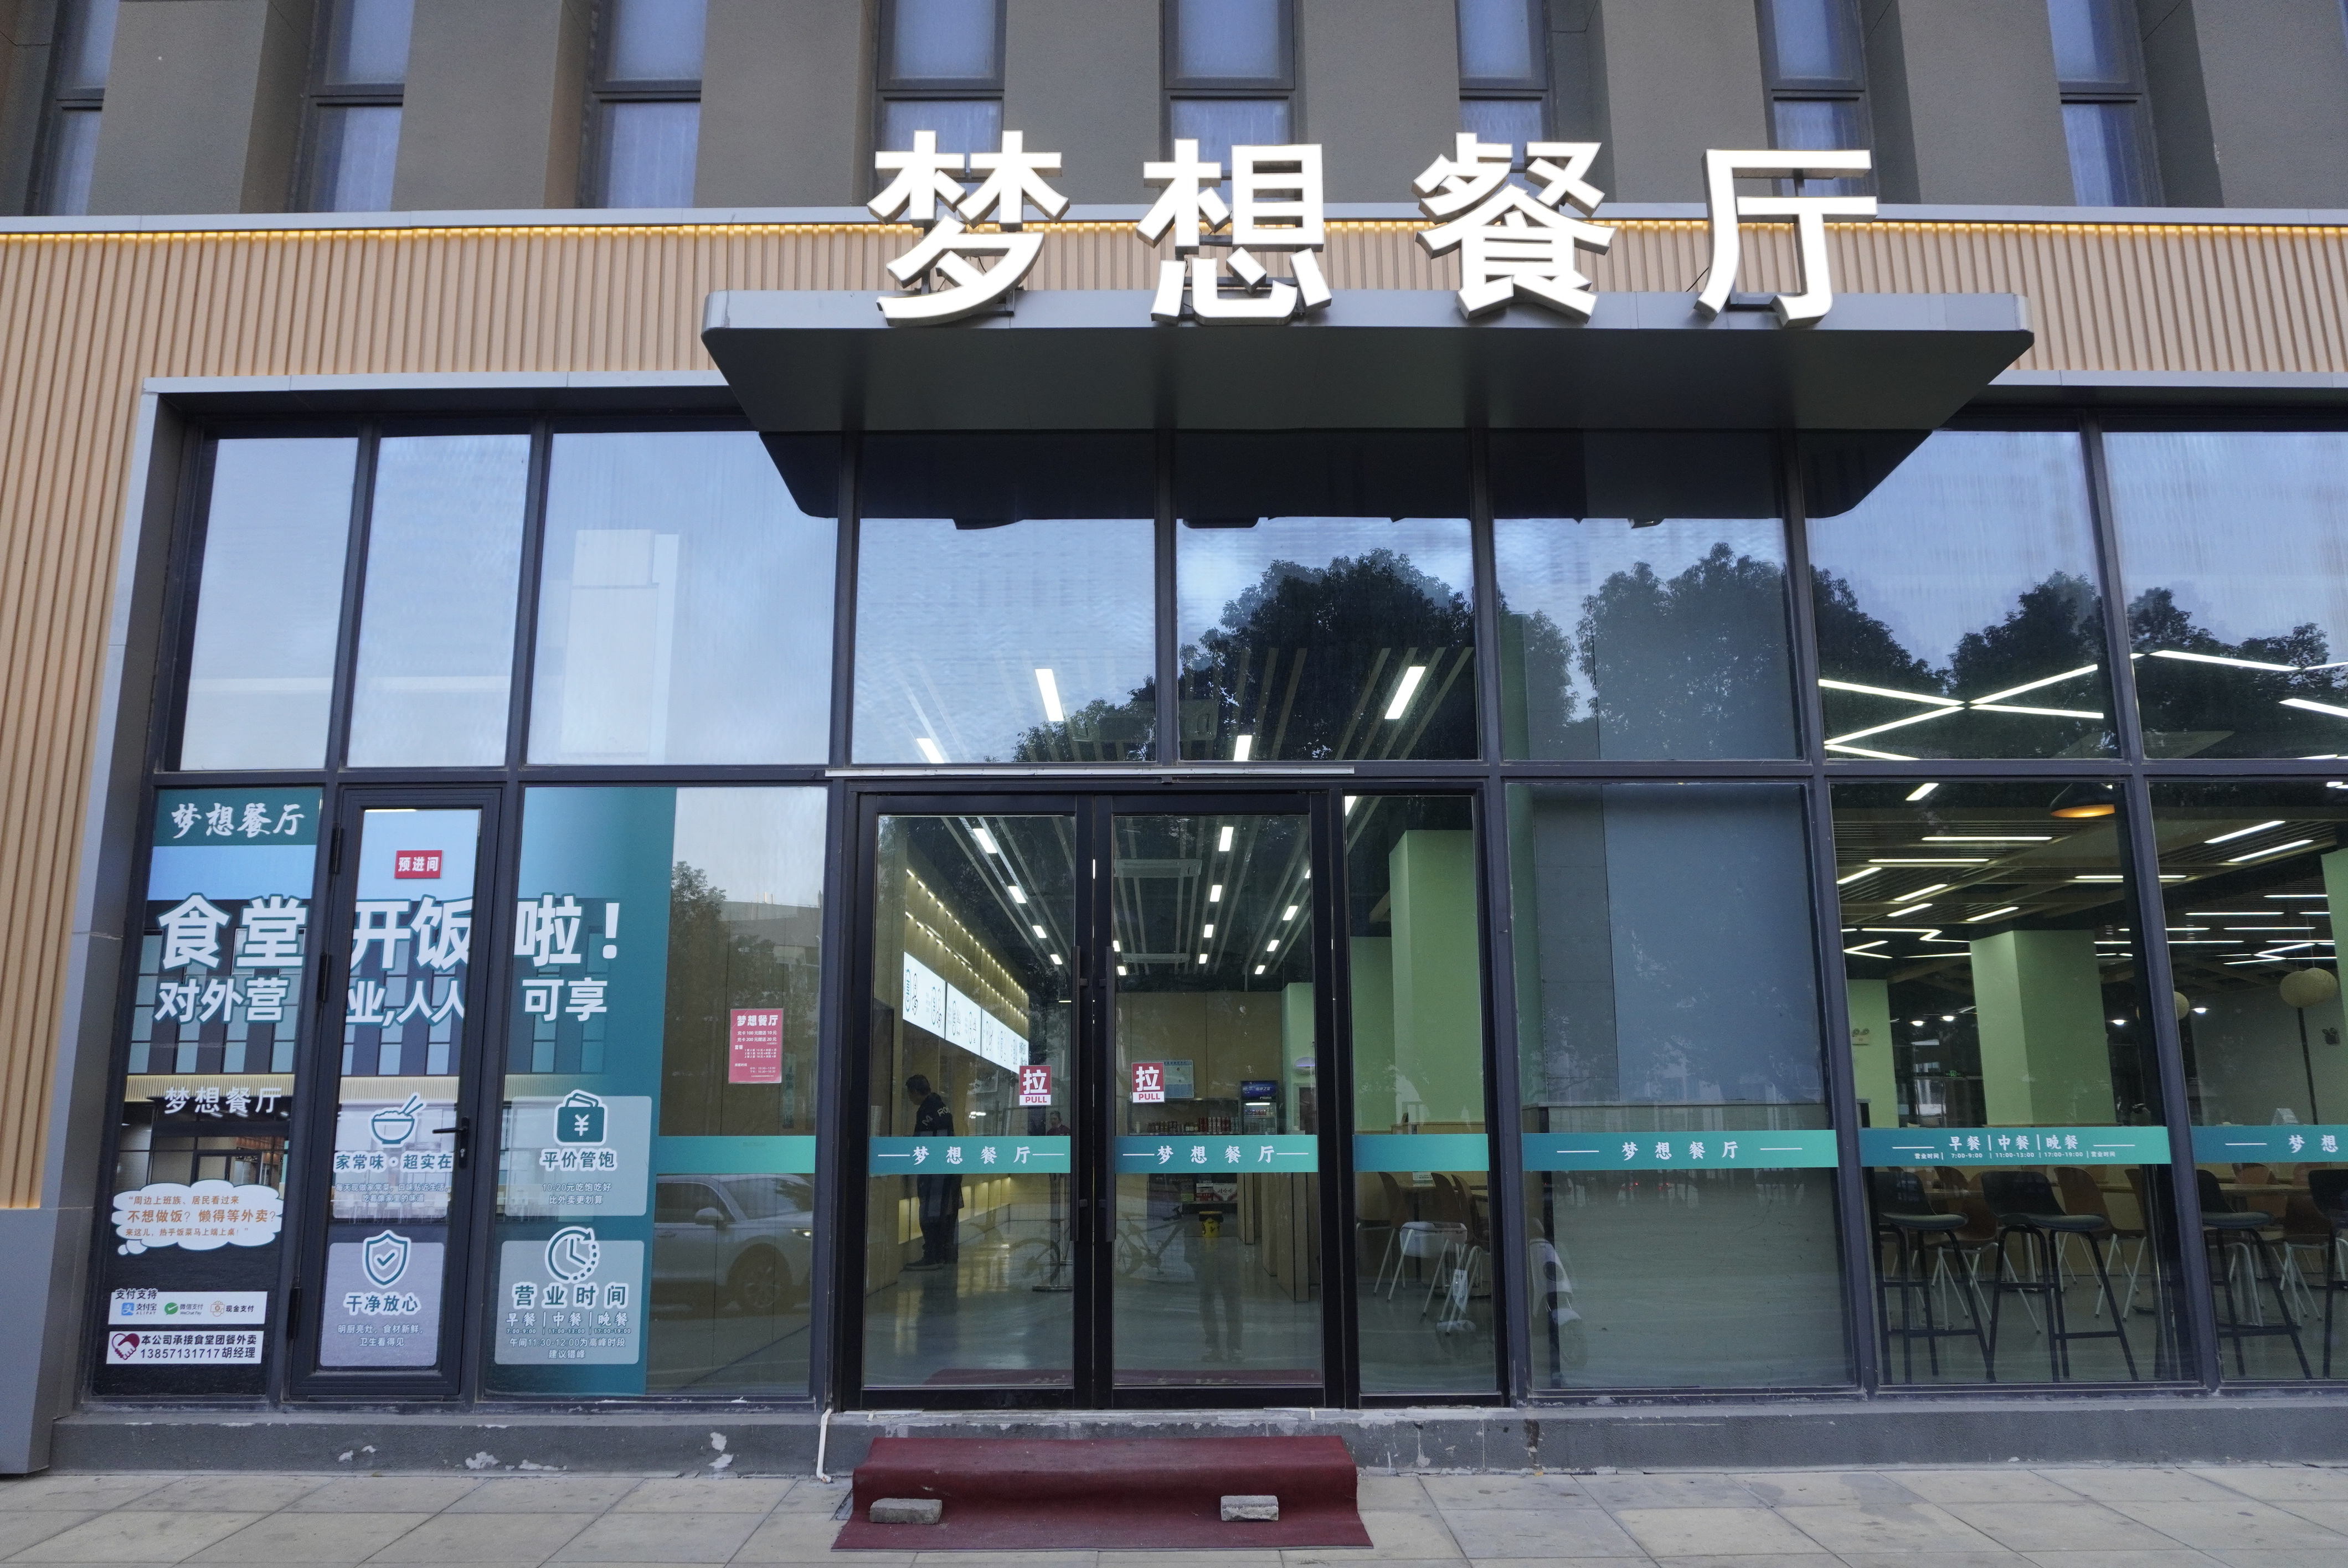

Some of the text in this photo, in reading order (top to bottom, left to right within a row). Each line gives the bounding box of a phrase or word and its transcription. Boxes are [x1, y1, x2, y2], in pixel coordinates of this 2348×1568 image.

[867, 130, 1878, 328] 梦想餐厅
[171, 803, 305, 838] 梦想餐厅
[398, 857, 439, 871] 预进间
[157, 893, 308, 970] 食堂
[350, 895, 472, 970] 开饭
[155, 977, 288, 1023] 对外营
[522, 977, 607, 1022] 可享
[737, 1015, 778, 1027] 梦想餐厅
[1022, 1069, 1048, 1095] 拉
[1136, 1066, 1161, 1091] 拉
[164, 1087, 282, 1113] 梦想餐厅
[1621, 1141, 1739, 1160] 梦想餐厅
[1949, 1134, 2078, 1151] 早餐 中餐 晚餐
[2288, 1134, 2339, 1153] 梦想
[542, 1151, 615, 1168] 平价管饱
[913, 1146, 1032, 1164] 梦想餐厅
[1156, 1145, 1275, 1164] 梦想餐厅
[542, 1183, 612, 1192] 10-20元吃饱吃好
[362, 1194, 425, 1203] 吃着像家里的味道
[549, 1195, 604, 1205] 比外卖更划算
[115, 1288, 158, 1299] 支付支持
[515, 1285, 626, 1306] 营业时间
[346, 1295, 418, 1312] 干净放心
[506, 1311, 628, 1327] 早餐 中餐 晚餐
[141, 1334, 257, 1345] 本公司承接食堂团餐外卖
[359, 1337, 404, 1346] 卫生看得见
[509, 1338, 626, 1347] 午间11:30-12:00为高峰时段
[548, 1350, 585, 1359] 建议错峰
